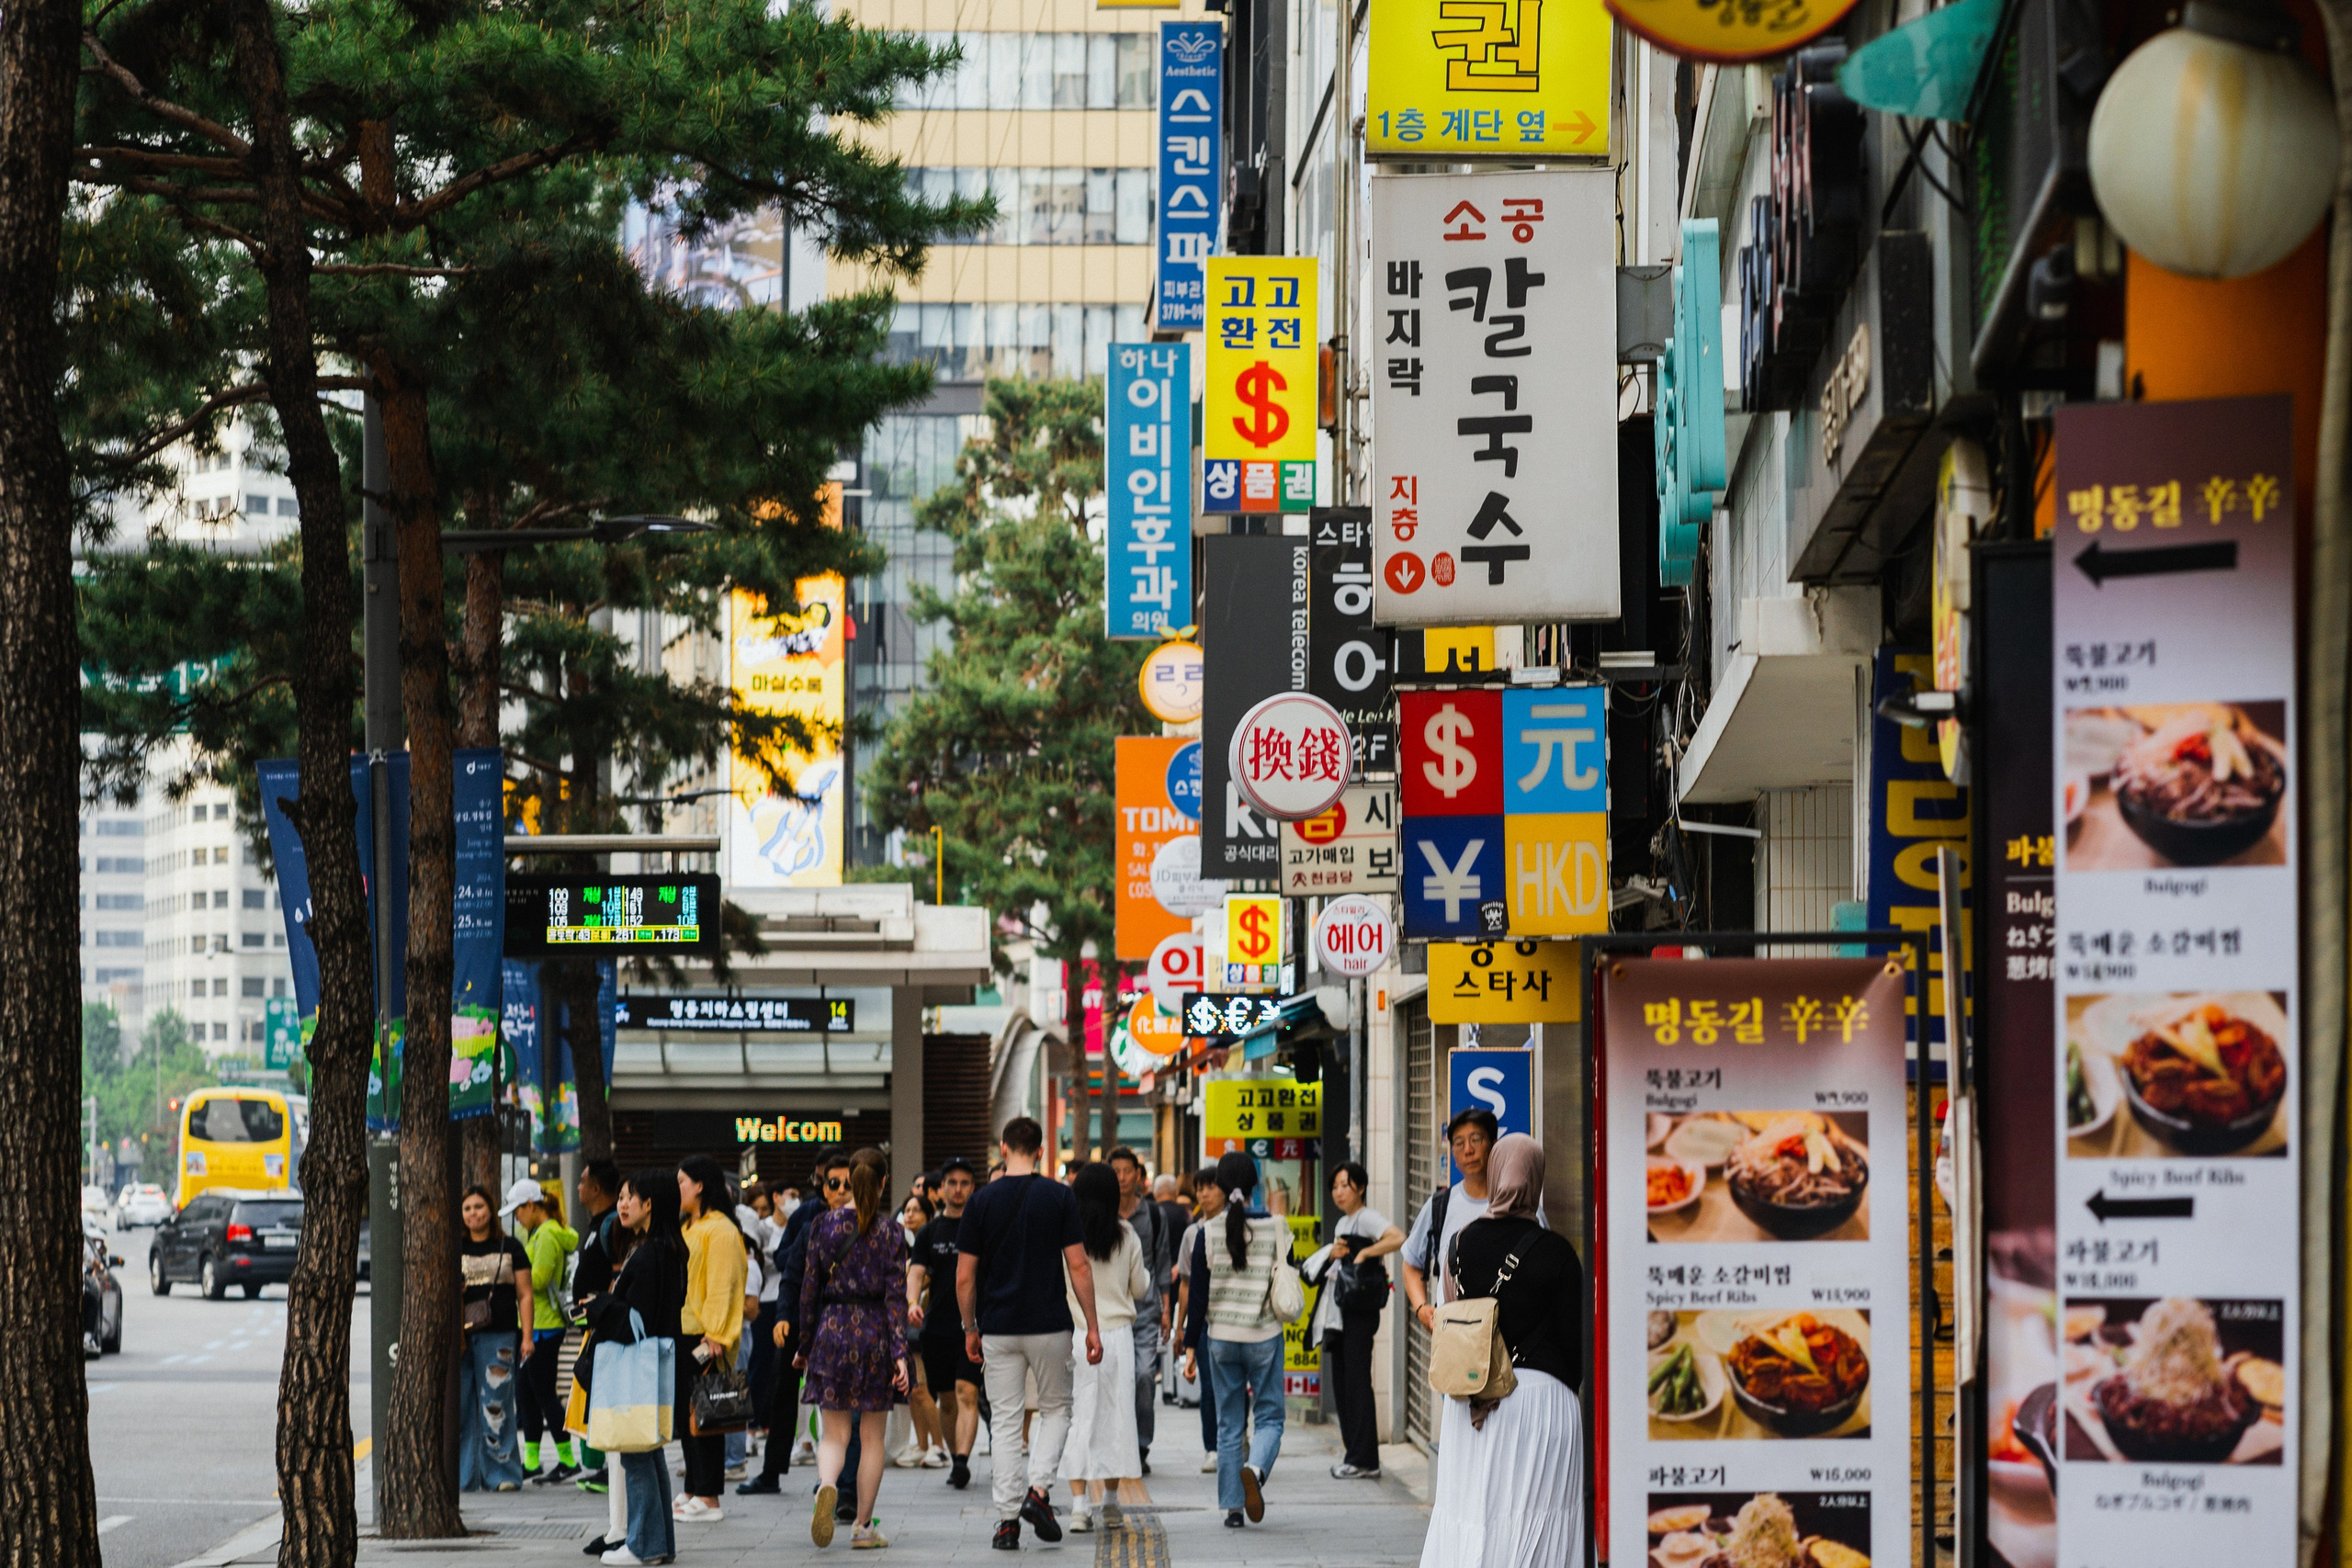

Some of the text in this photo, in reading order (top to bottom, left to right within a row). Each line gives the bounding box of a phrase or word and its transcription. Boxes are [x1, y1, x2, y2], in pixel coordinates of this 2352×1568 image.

[1432, 0, 1542, 92] 권
[1165, 65, 1217, 77] Aesthetic
[1378, 109, 1545, 142] 1층 계단 옆
[1167, 87, 1212, 273] 스킨스파
[1443, 198, 1544, 243] 소공
[1221, 276, 1301, 308] 고고
[1220, 317, 1302, 349] 환전
[1385, 260, 1423, 396] 바지락
[1120, 348, 1178, 377] 하나
[1445, 257, 1545, 585] 칼국수
[1127, 378, 1178, 610] 이비인후과
[1206, 462, 1314, 501] 상품권
[1390, 476, 1419, 541] 지층
[2067, 479, 2181, 533] 명동길
[1291, 547, 1309, 690] korea telecom
[1248, 727, 1340, 782] 換錢
[1517, 705, 1600, 793] 元
[1289, 847, 1354, 864] 고가매입
[1516, 840, 1602, 918] HKD
[1328, 923, 1383, 954] 헤어
[1343, 957, 1368, 970] hair
[1453, 970, 1552, 1002] 스타사
[830, 1001, 847, 1018] 14
[1644, 997, 1765, 1045] 명동길
[736, 1116, 842, 1144] Welcom
[1646, 1290, 1757, 1307] Spicy Beef Ribs
[1648, 1465, 1725, 1487] 파불고기
